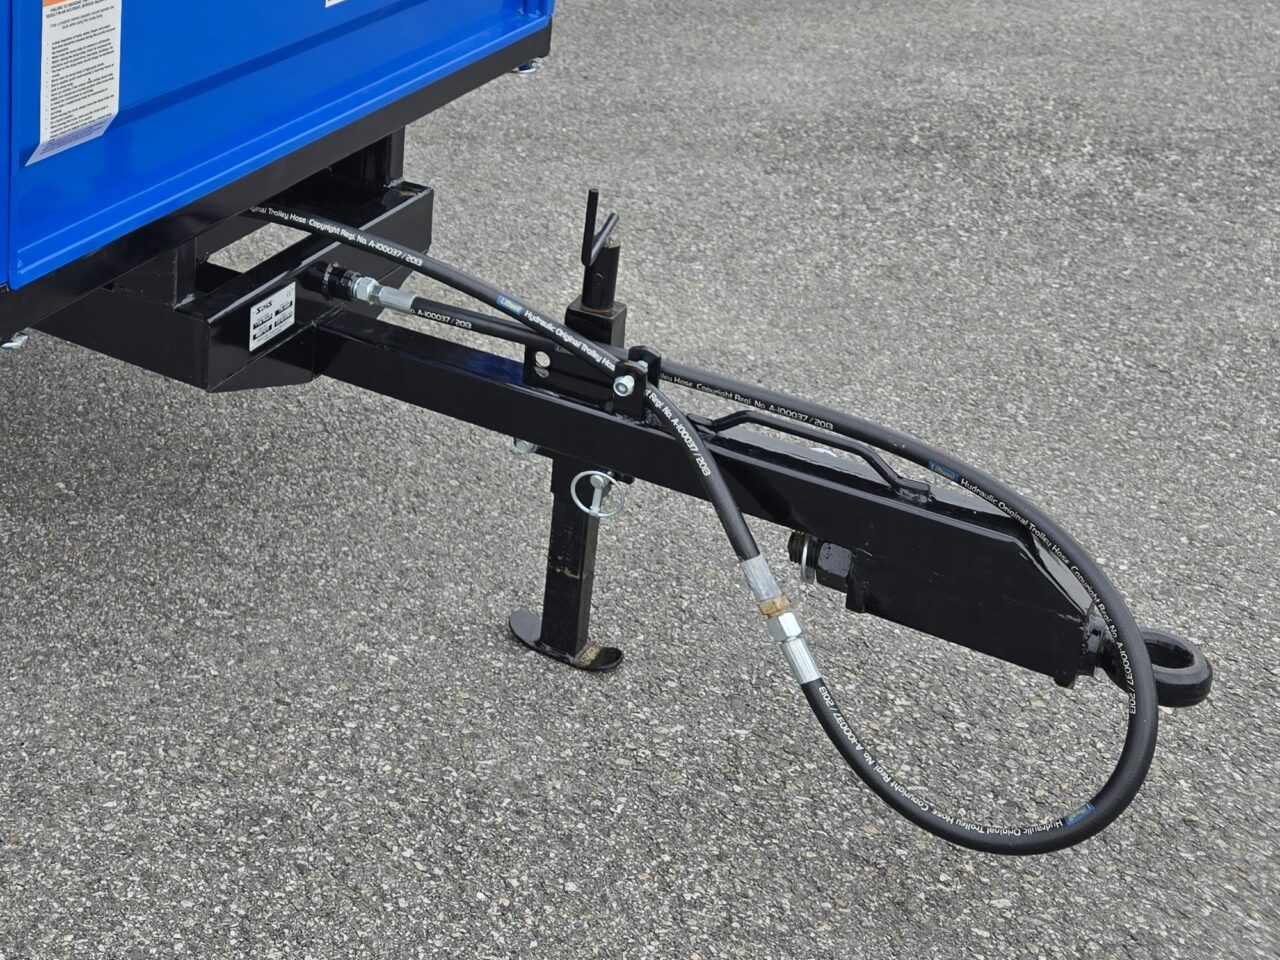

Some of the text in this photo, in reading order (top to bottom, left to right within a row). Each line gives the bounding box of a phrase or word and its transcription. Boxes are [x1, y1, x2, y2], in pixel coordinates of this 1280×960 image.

[268, 207, 290, 220] Trolley
[290, 212, 307, 224] Hose
[308, 218, 340, 235] Copyright
[524, 310, 616, 372] Hydraulic Original Trolley Hos
[674, 376, 693, 387] Hose
[960, 478, 998, 505] Hydraulic
[998, 501, 1028, 526] Original
[1028, 522, 1052, 548] Trolley
[1052, 544, 1070, 564] Hose
[1070, 565, 1100, 603] Copyright
[890, 780, 930, 812] Copyright
[932, 808, 954, 824] Hose
[956, 819, 984, 834] Trolley
[986, 827, 1021, 836] Original
[1024, 820, 1064, 836] Hydraulic
